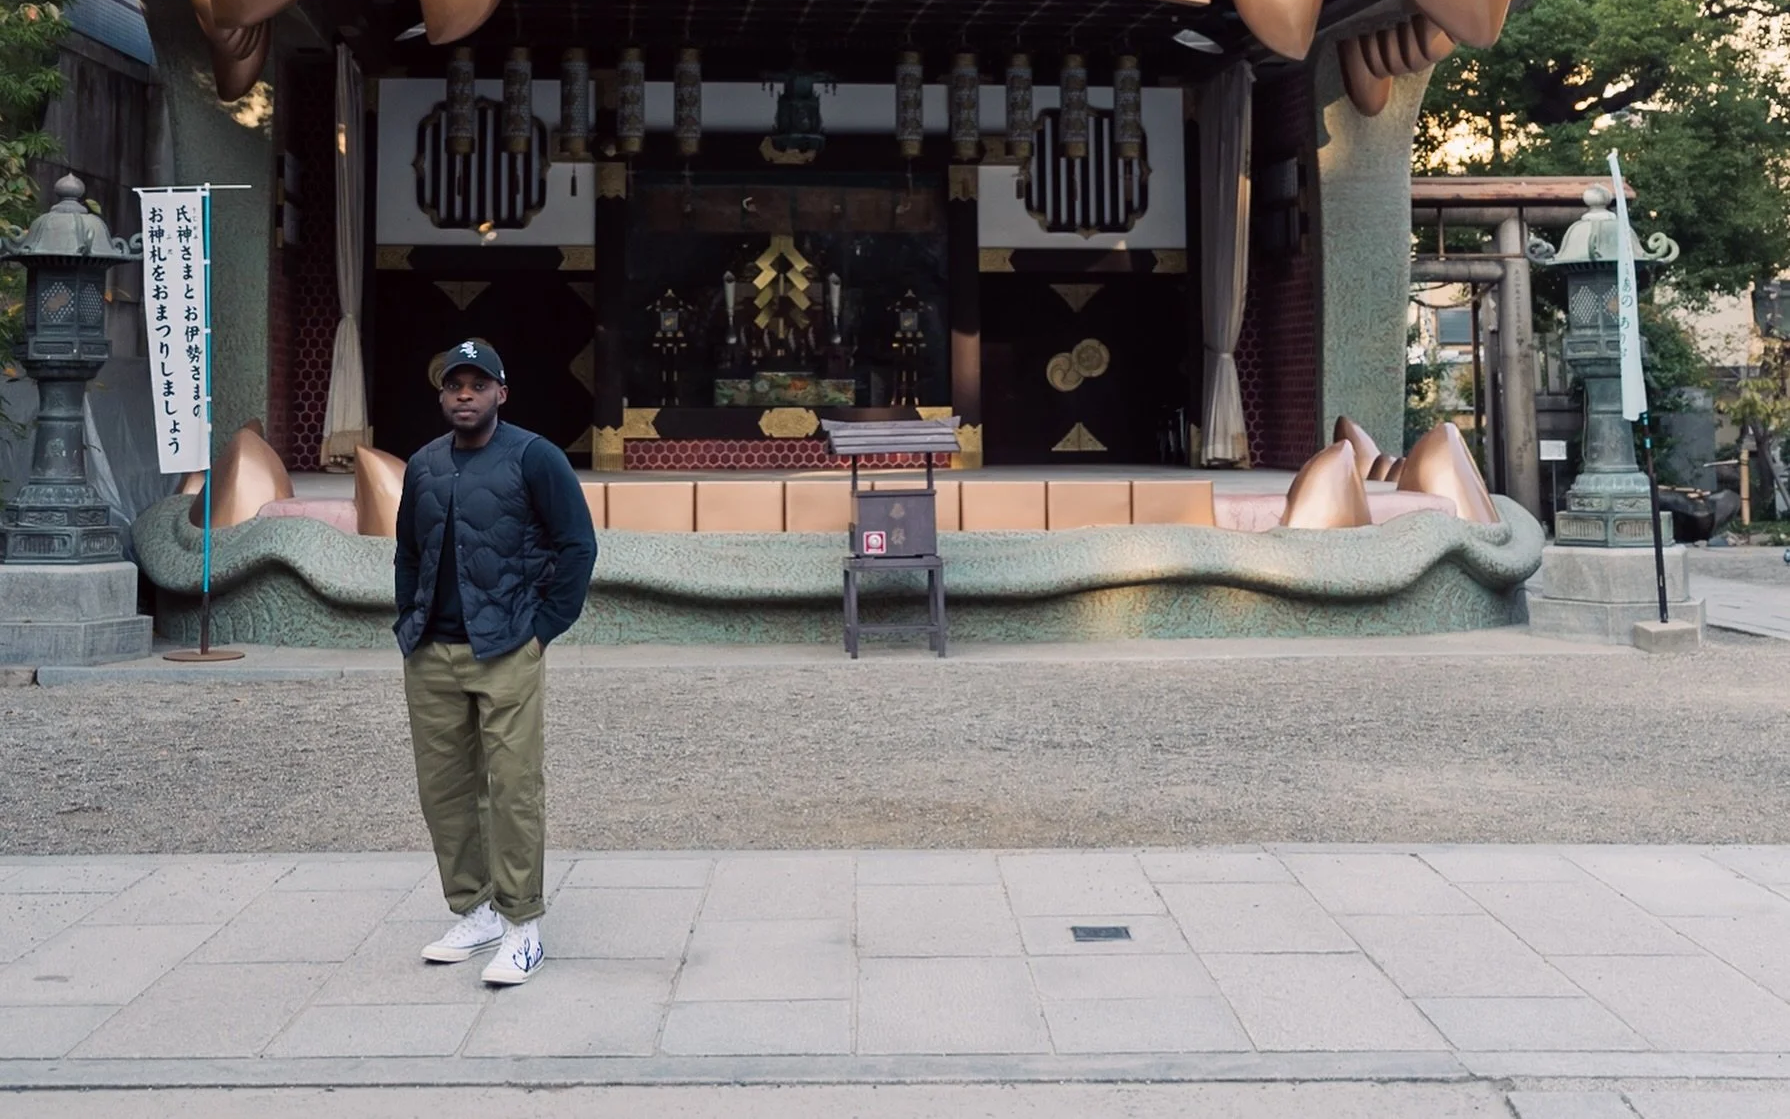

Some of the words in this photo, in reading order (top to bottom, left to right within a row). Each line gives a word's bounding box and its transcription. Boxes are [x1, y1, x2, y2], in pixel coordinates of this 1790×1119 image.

[148, 207, 182, 456] お神札をおまつりしましょう
